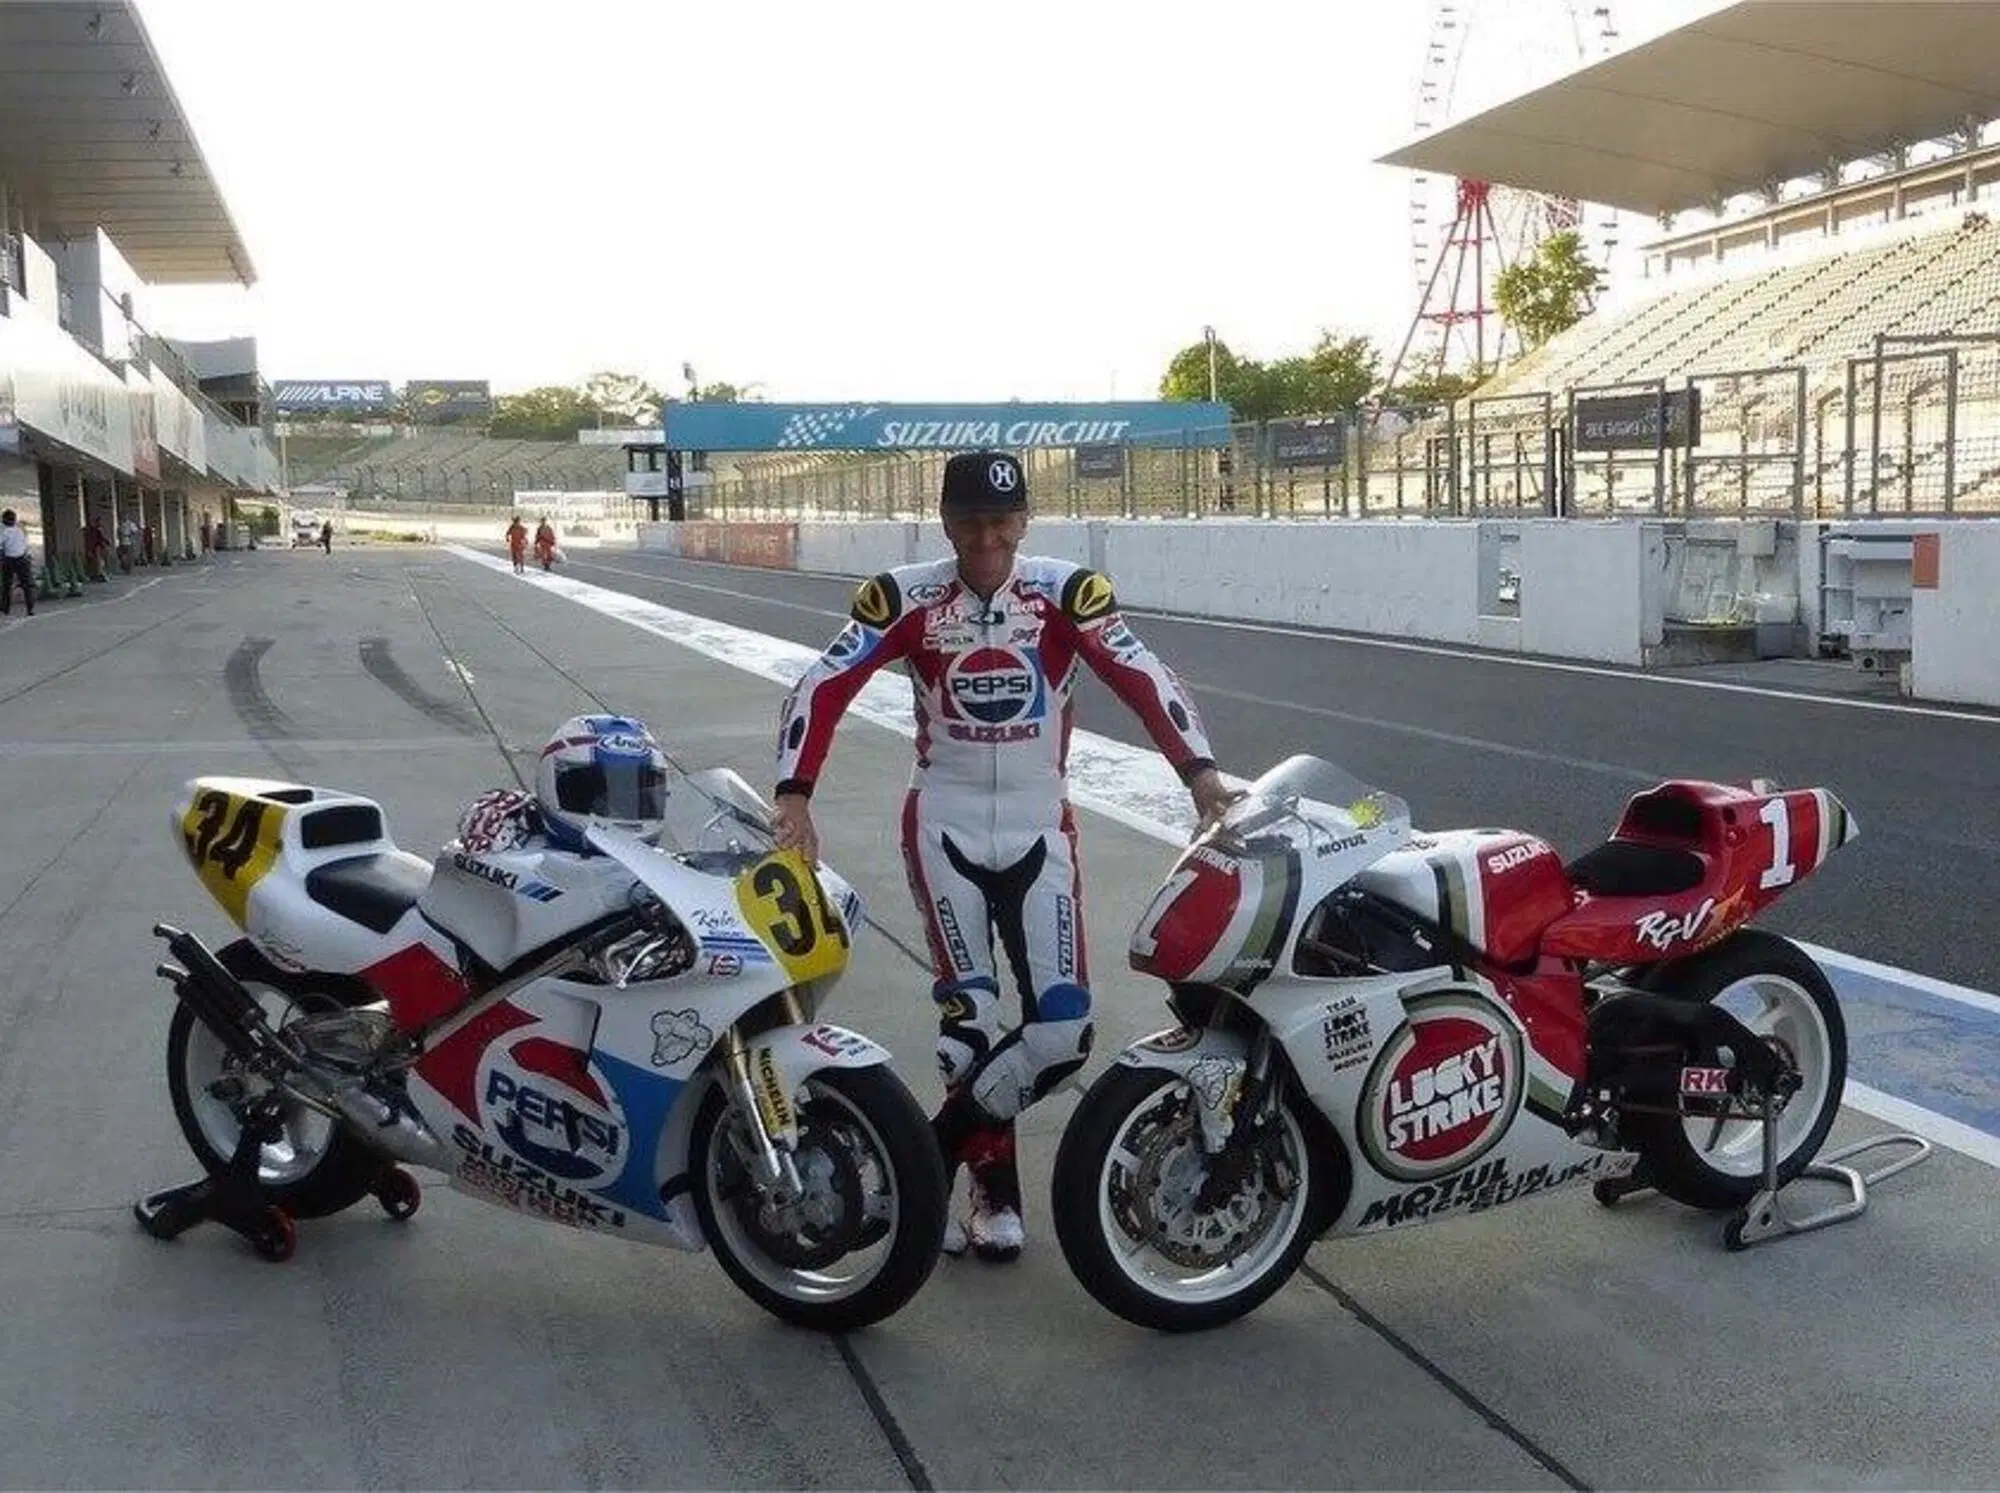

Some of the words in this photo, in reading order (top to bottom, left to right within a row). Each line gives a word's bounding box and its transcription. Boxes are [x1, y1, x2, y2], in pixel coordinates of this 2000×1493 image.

[314, 384, 385, 401] ALPINE
[877, 421, 999, 447] SUZUKA
[1005, 420, 1130, 445] CIRCUIT
[951, 675, 1033, 695] PEPSI
[947, 723, 1040, 742] SUZUKI
[454, 852, 519, 889] SUZUKI
[1316, 834, 1367, 859] MOTUL
[1758, 797, 1796, 890] 1
[759, 1047, 793, 1126] MICHELIN
[1389, 1037, 1499, 1115] LUCKY
[1685, 1069, 1730, 1092] RK
[485, 1069, 619, 1157] PEPSI
[1388, 1075, 1503, 1149] STRIKE
[451, 1124, 627, 1228] SUZUKI
[1356, 1156, 1507, 1229] MOTUL
